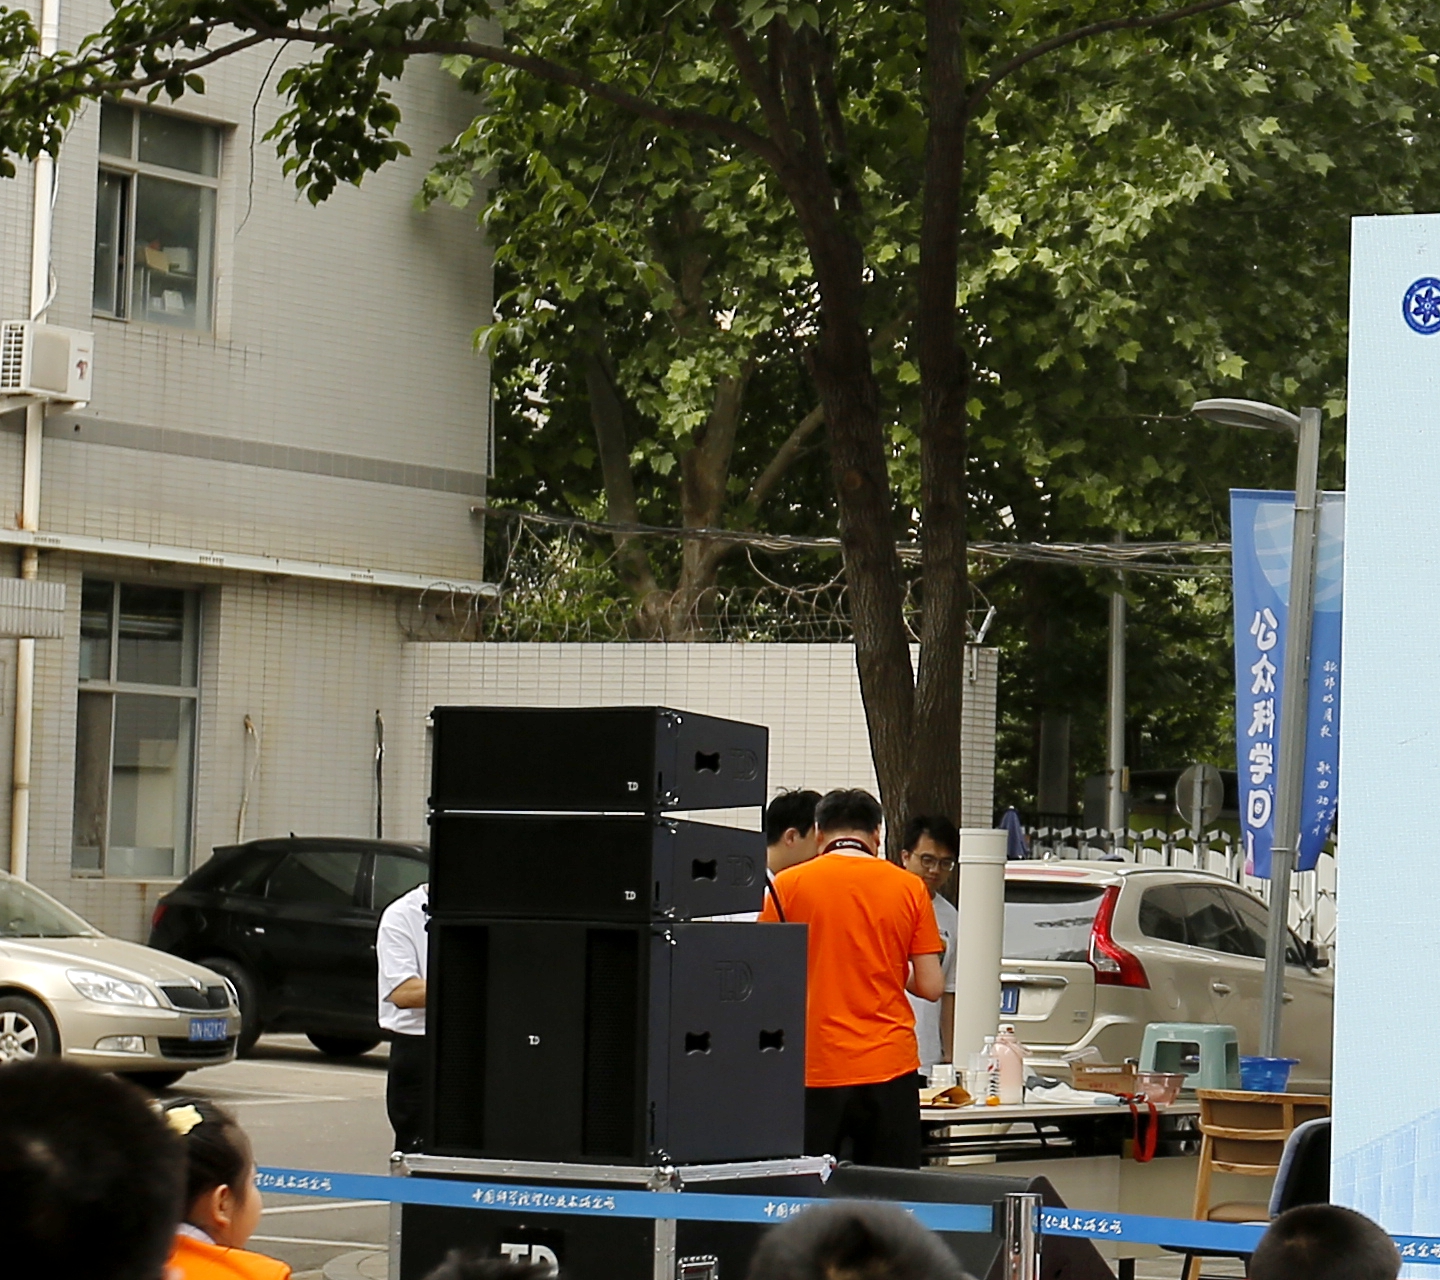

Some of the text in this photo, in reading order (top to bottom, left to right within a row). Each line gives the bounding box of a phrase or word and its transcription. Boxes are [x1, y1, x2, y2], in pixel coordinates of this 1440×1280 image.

[1247, 606, 1278, 828] 公众科学日
